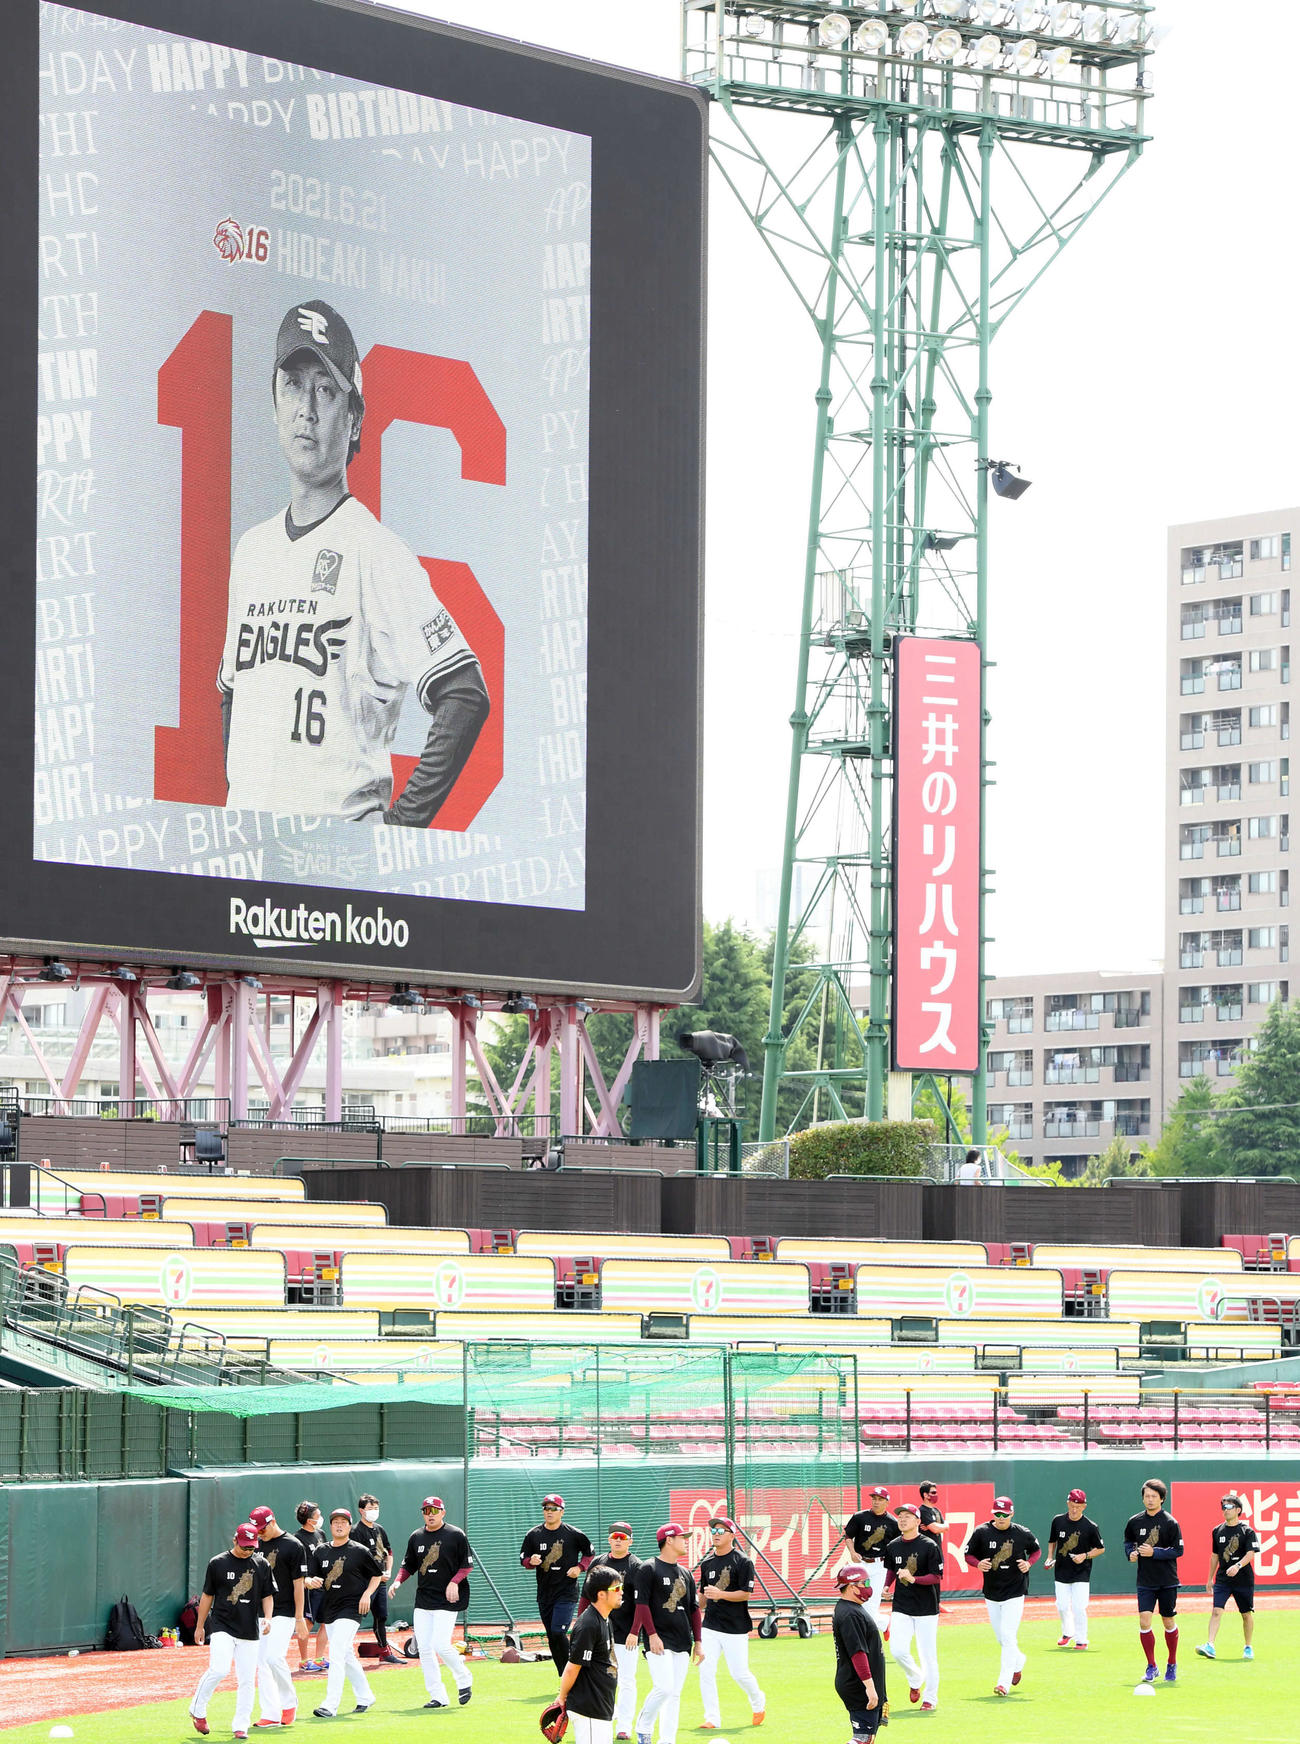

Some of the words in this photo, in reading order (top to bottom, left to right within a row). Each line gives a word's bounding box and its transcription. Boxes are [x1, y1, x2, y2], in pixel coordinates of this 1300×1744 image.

[148, 43, 248, 94] HAPPY
[307, 90, 453, 140] BIRTHDAY
[463, 135, 571, 179] HAPPY
[270, 169, 388, 233] 2021.6.21
[245, 226, 270, 263] 16
[277, 229, 366, 289] HIDEAKI
[247, 598, 318, 617] RAKUTEN
[235, 615, 353, 677] EAGLES
[290, 687, 327, 745] 16
[919, 654, 960, 1055] 三井のリハウス
[230, 898, 342, 942] Rakuten
[346, 904, 410, 948] kobo
[540, 1543, 547, 1551] 10
[895, 1556, 902, 1564] 10
[989, 1541, 997, 1549] 10
[226, 1571, 235, 1580] 10
[582, 1649, 593, 1661] 10
